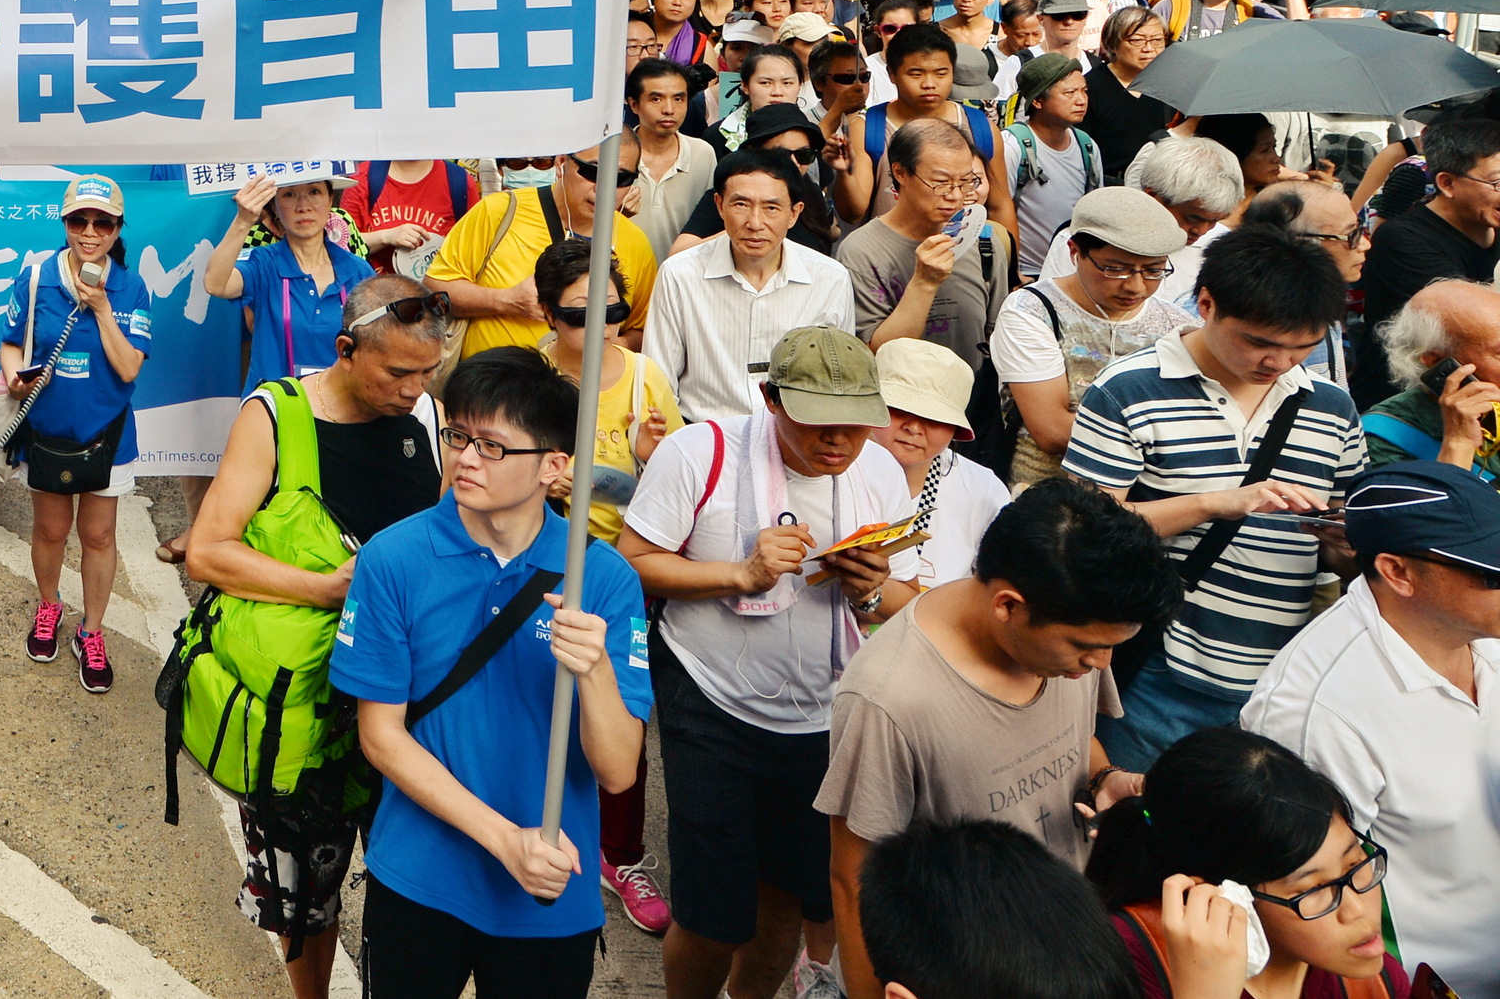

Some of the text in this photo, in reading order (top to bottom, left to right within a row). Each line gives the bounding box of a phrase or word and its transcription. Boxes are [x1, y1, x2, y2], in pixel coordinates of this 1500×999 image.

[192, 163, 237, 186] 我撐
[371, 204, 447, 233] GENUINE
[987, 745, 1082, 814] DARKNESS
